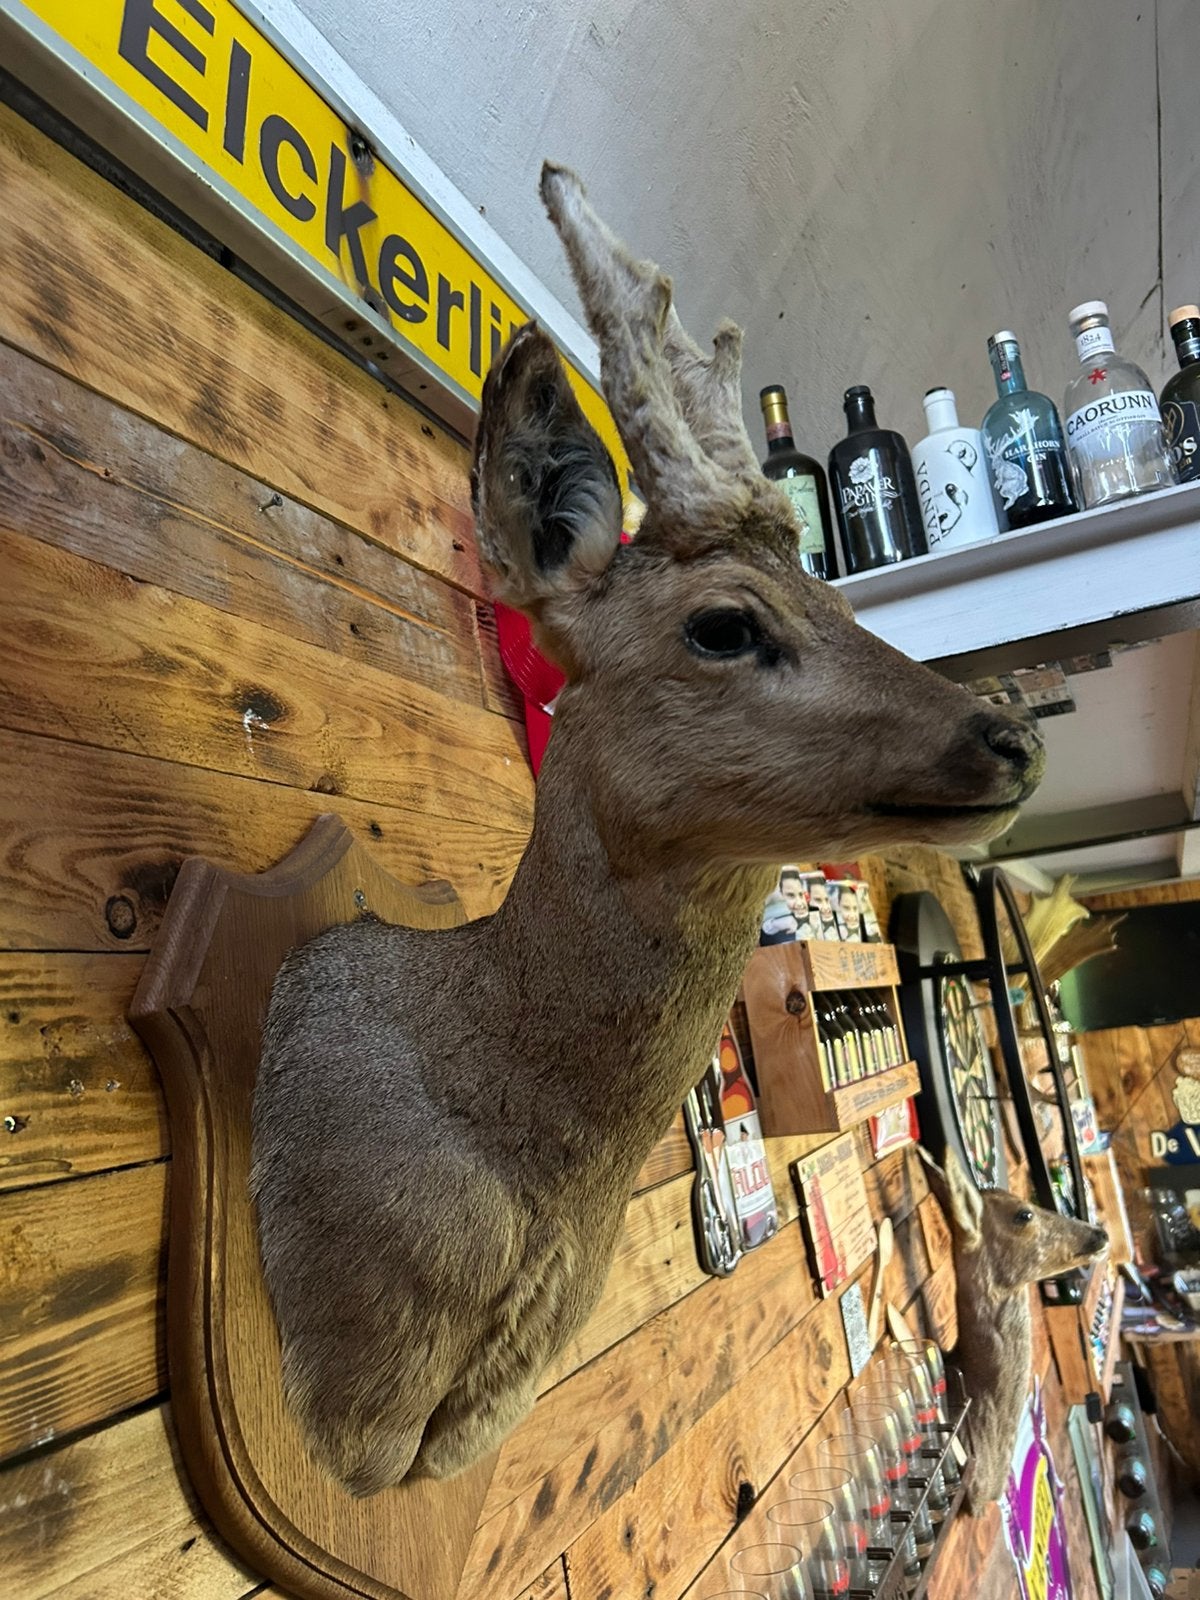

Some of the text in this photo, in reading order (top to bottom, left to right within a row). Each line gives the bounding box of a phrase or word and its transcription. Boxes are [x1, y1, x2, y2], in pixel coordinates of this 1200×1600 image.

[118, 0, 518, 380] Elckerli
[1066, 395, 1153, 436] CAORUNN
[916, 461, 942, 547] PANDA
[1151, 1131, 1180, 1158] De
